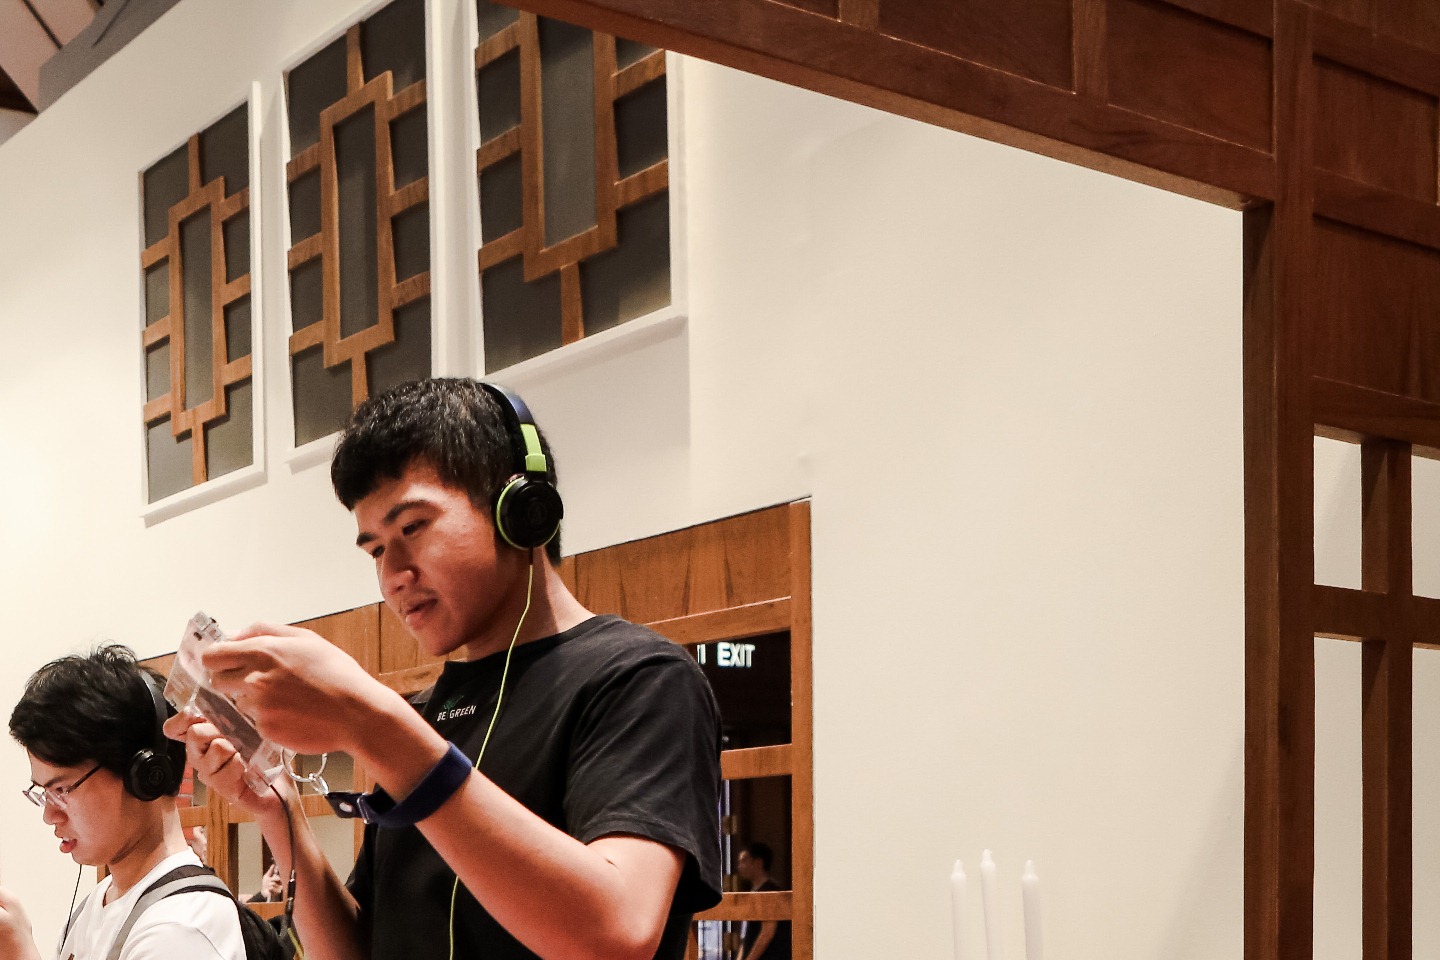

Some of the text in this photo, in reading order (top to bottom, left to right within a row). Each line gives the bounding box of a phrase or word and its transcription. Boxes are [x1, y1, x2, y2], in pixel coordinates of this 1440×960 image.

[717, 641, 756, 667] EXIT
[437, 704, 477, 722] BE GREEN
